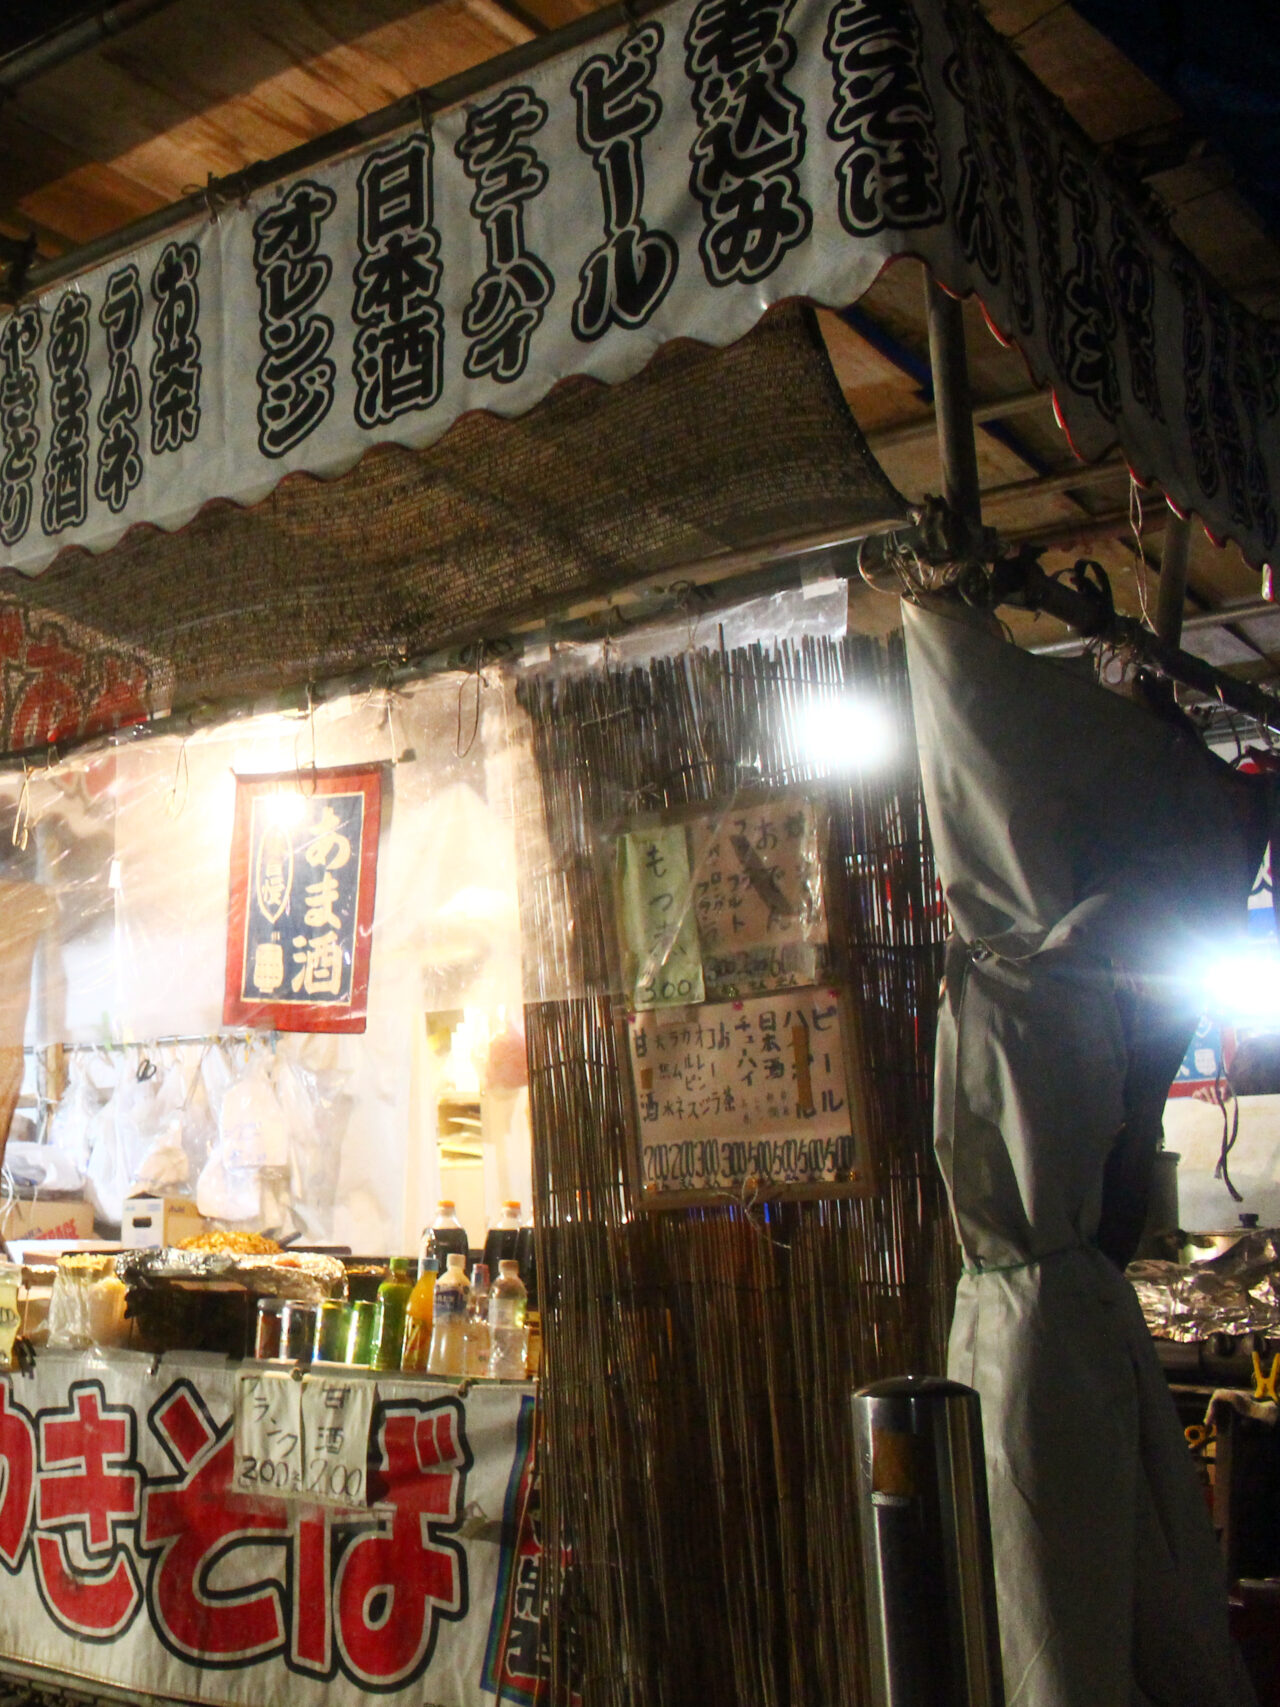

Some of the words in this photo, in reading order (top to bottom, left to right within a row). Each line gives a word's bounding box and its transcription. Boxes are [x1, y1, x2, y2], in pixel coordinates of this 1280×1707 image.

[354, 133, 444, 430] 日本酒
[454, 84, 556, 383] チューハイ
[570, 19, 680, 344] ビール
[40, 289, 90, 537] あま酒
[95, 262, 145, 513] ラムネ
[150, 240, 202, 455] お茶
[254, 178, 338, 458] オレンジ
[291, 805, 352, 996] あま酒
[640, 974, 693, 1004] 300
[758, 1009, 785, 1080] 日本酒
[812, 1005, 844, 1114] ビール
[308, 1458, 363, 1498] 200
[314, 1383, 353, 1456] 甘酒
